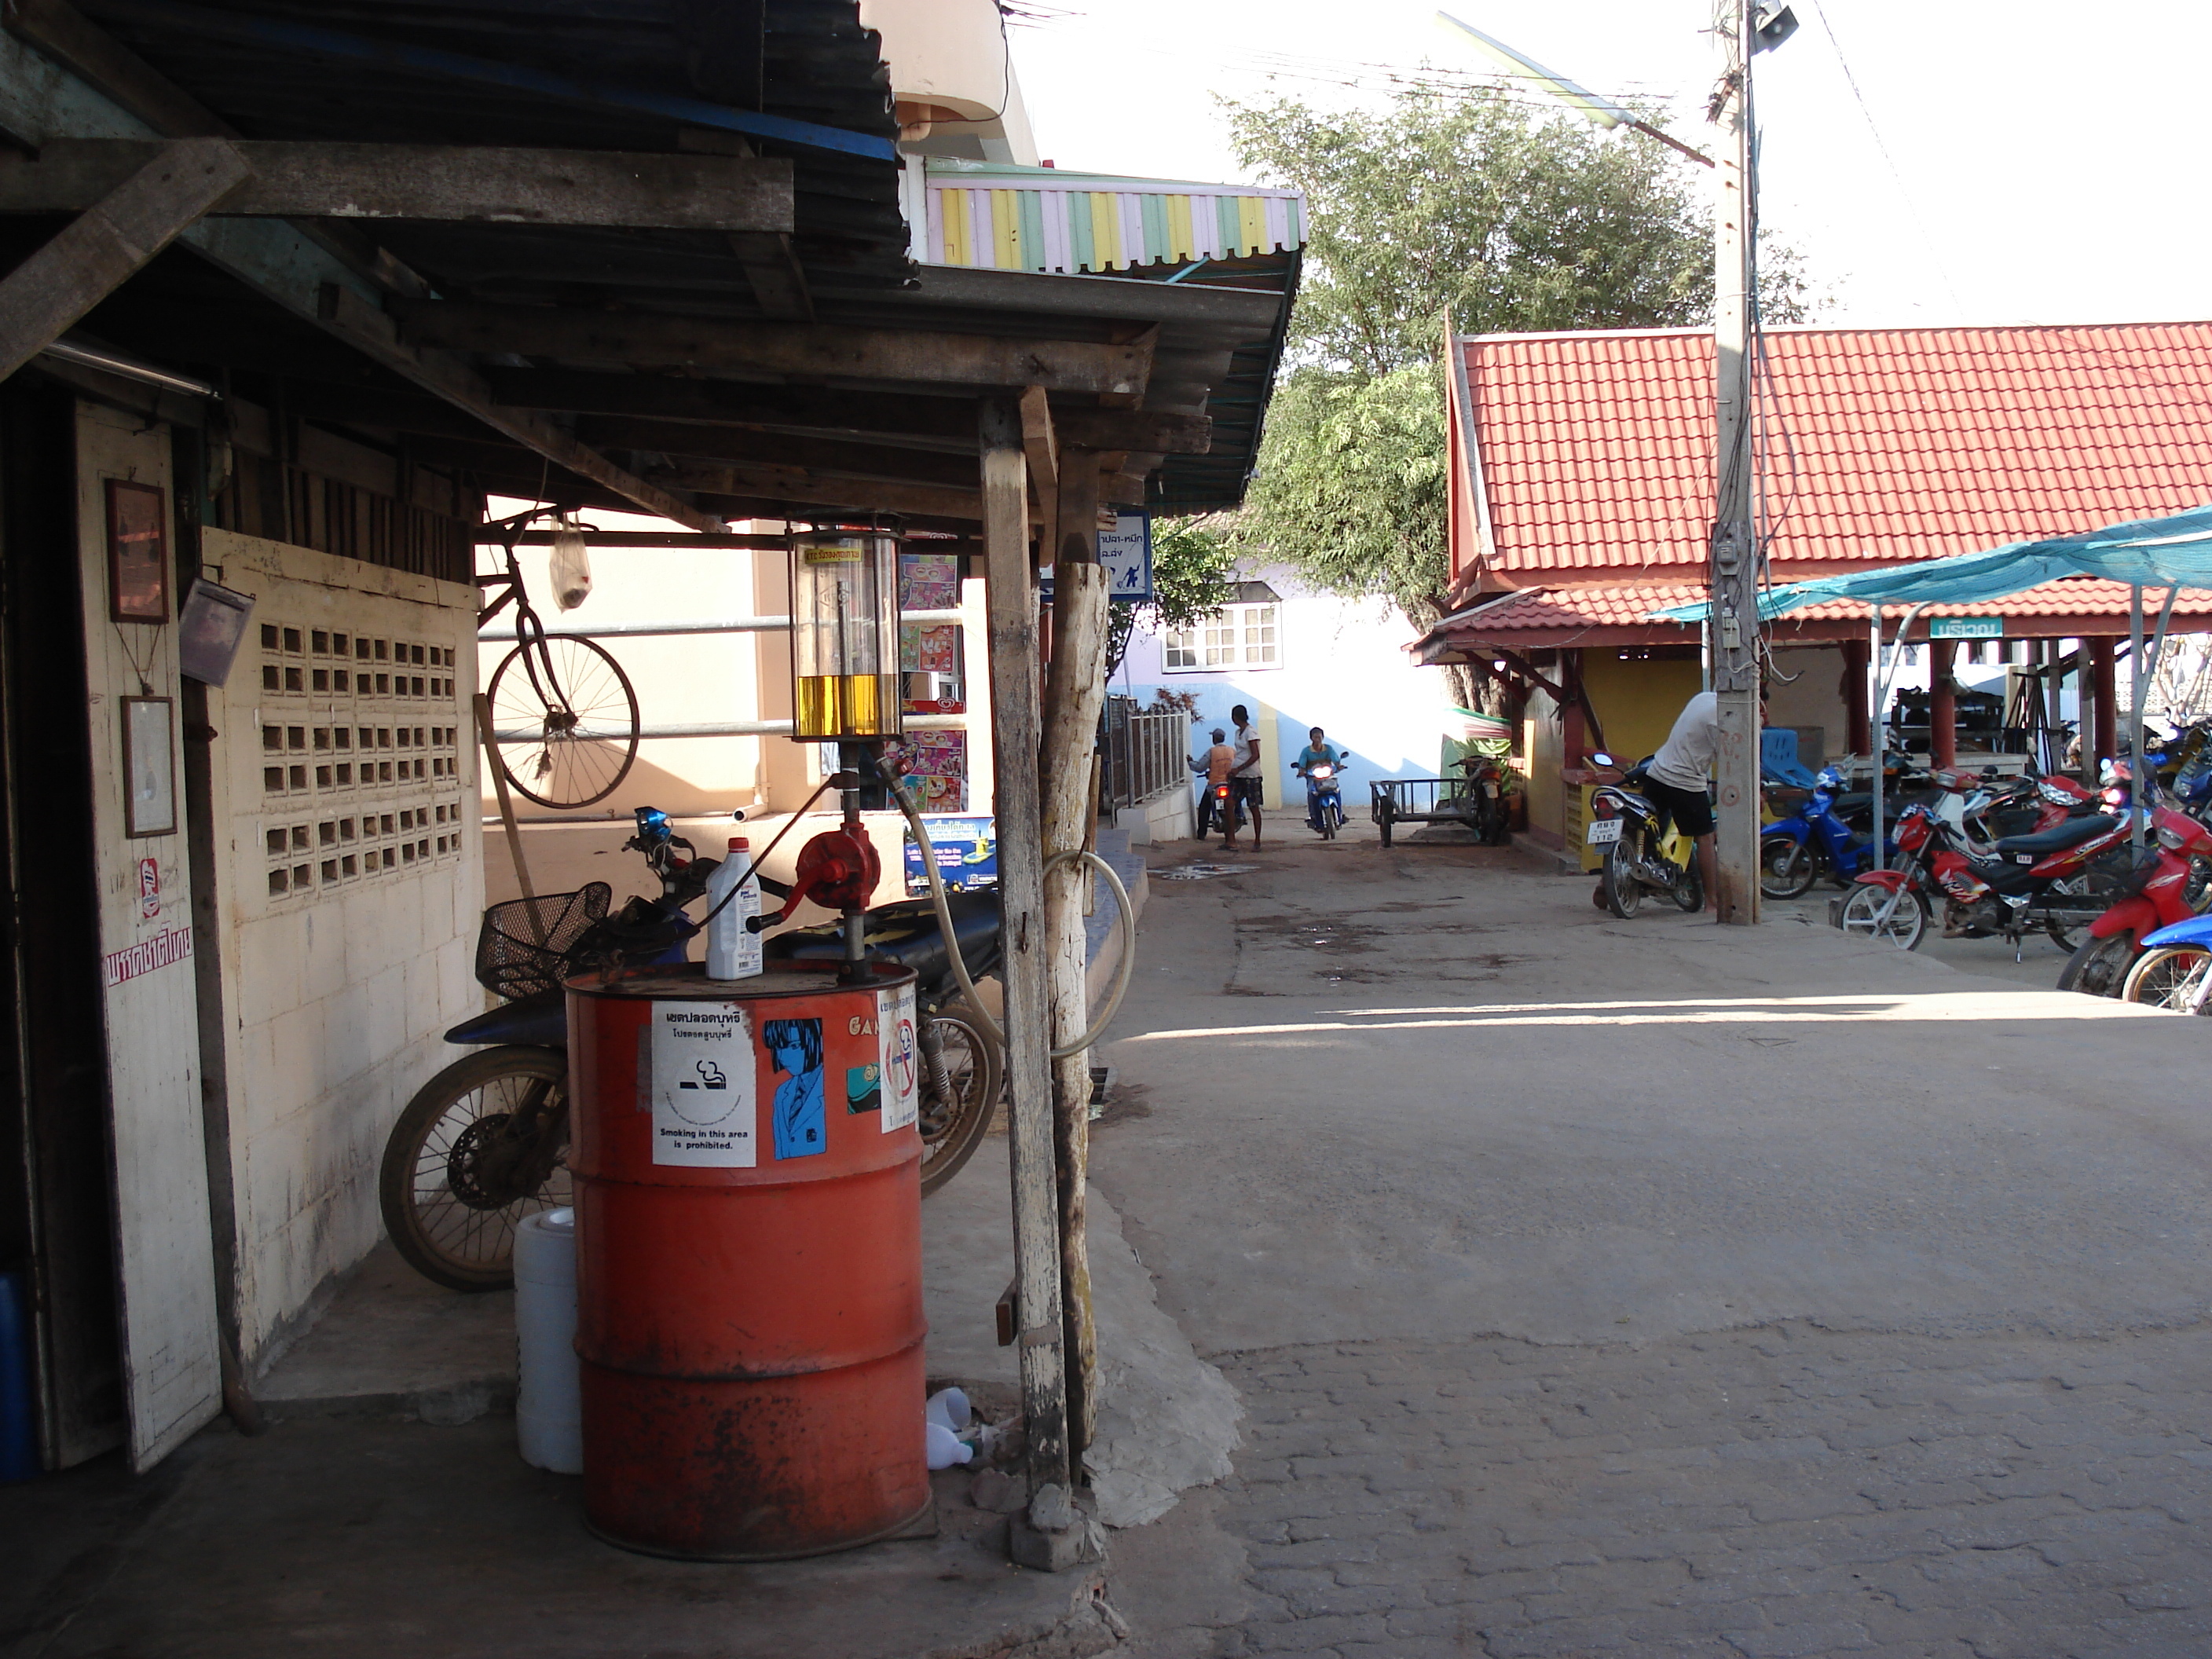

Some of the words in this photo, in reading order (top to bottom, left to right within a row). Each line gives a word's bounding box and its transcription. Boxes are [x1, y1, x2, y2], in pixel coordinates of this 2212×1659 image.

[105, 921, 193, 987] พรรคชาติไทย
[661, 1128, 696, 1139] Smoking
[686, 1141, 733, 1150] prohibited.
